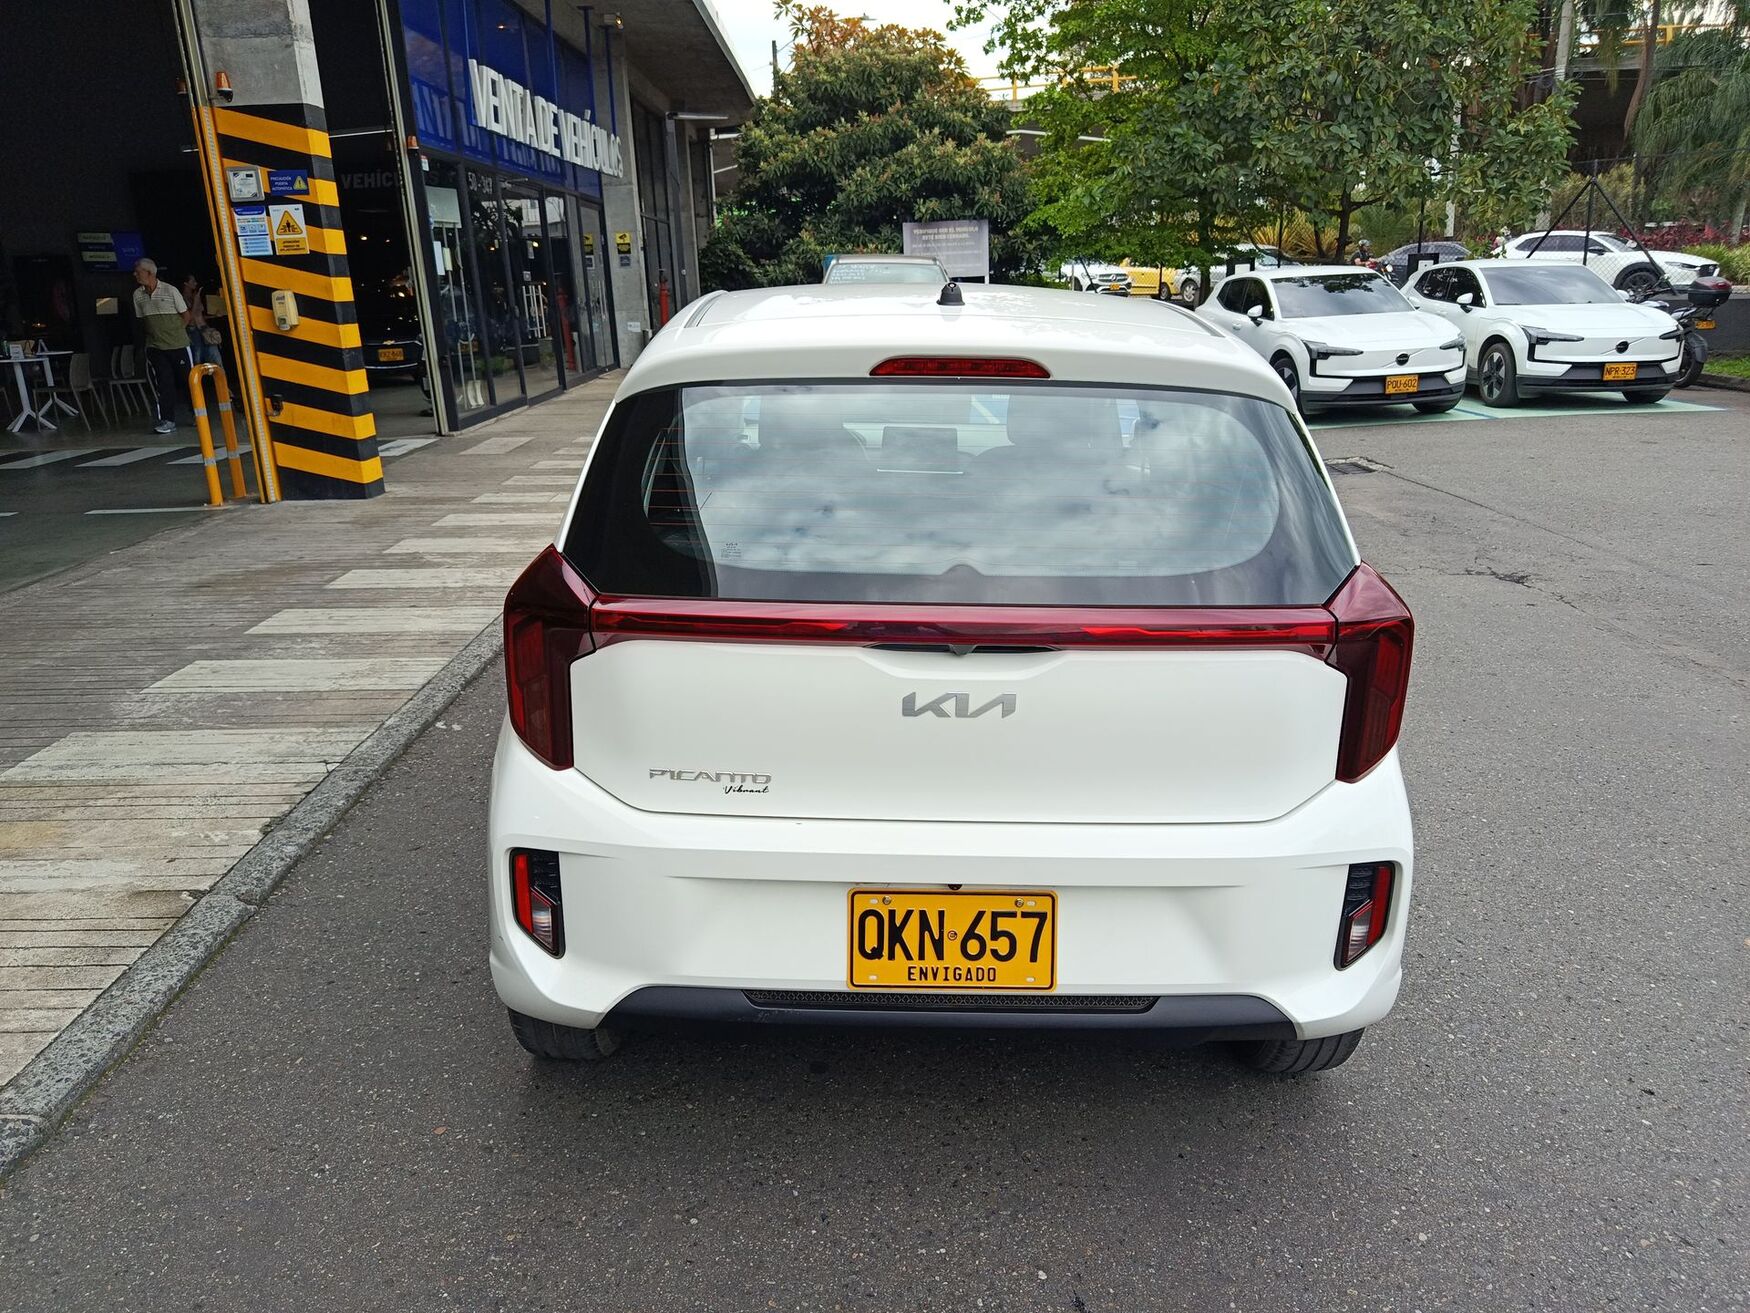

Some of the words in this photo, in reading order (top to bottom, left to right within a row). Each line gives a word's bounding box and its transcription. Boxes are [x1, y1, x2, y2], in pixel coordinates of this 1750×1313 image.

[468, 58, 539, 149] VENTA
[533, 95, 561, 157] DE
[558, 109, 624, 178] VEHÍCULOS
[902, 691, 1016, 719] KIA
[649, 768, 772, 785] PICANTO
[723, 785, 770, 795] Vibrant
[857, 908, 945, 962] QKN
[960, 910, 1048, 963] 657
[907, 966, 997, 982] ENVIGADO
